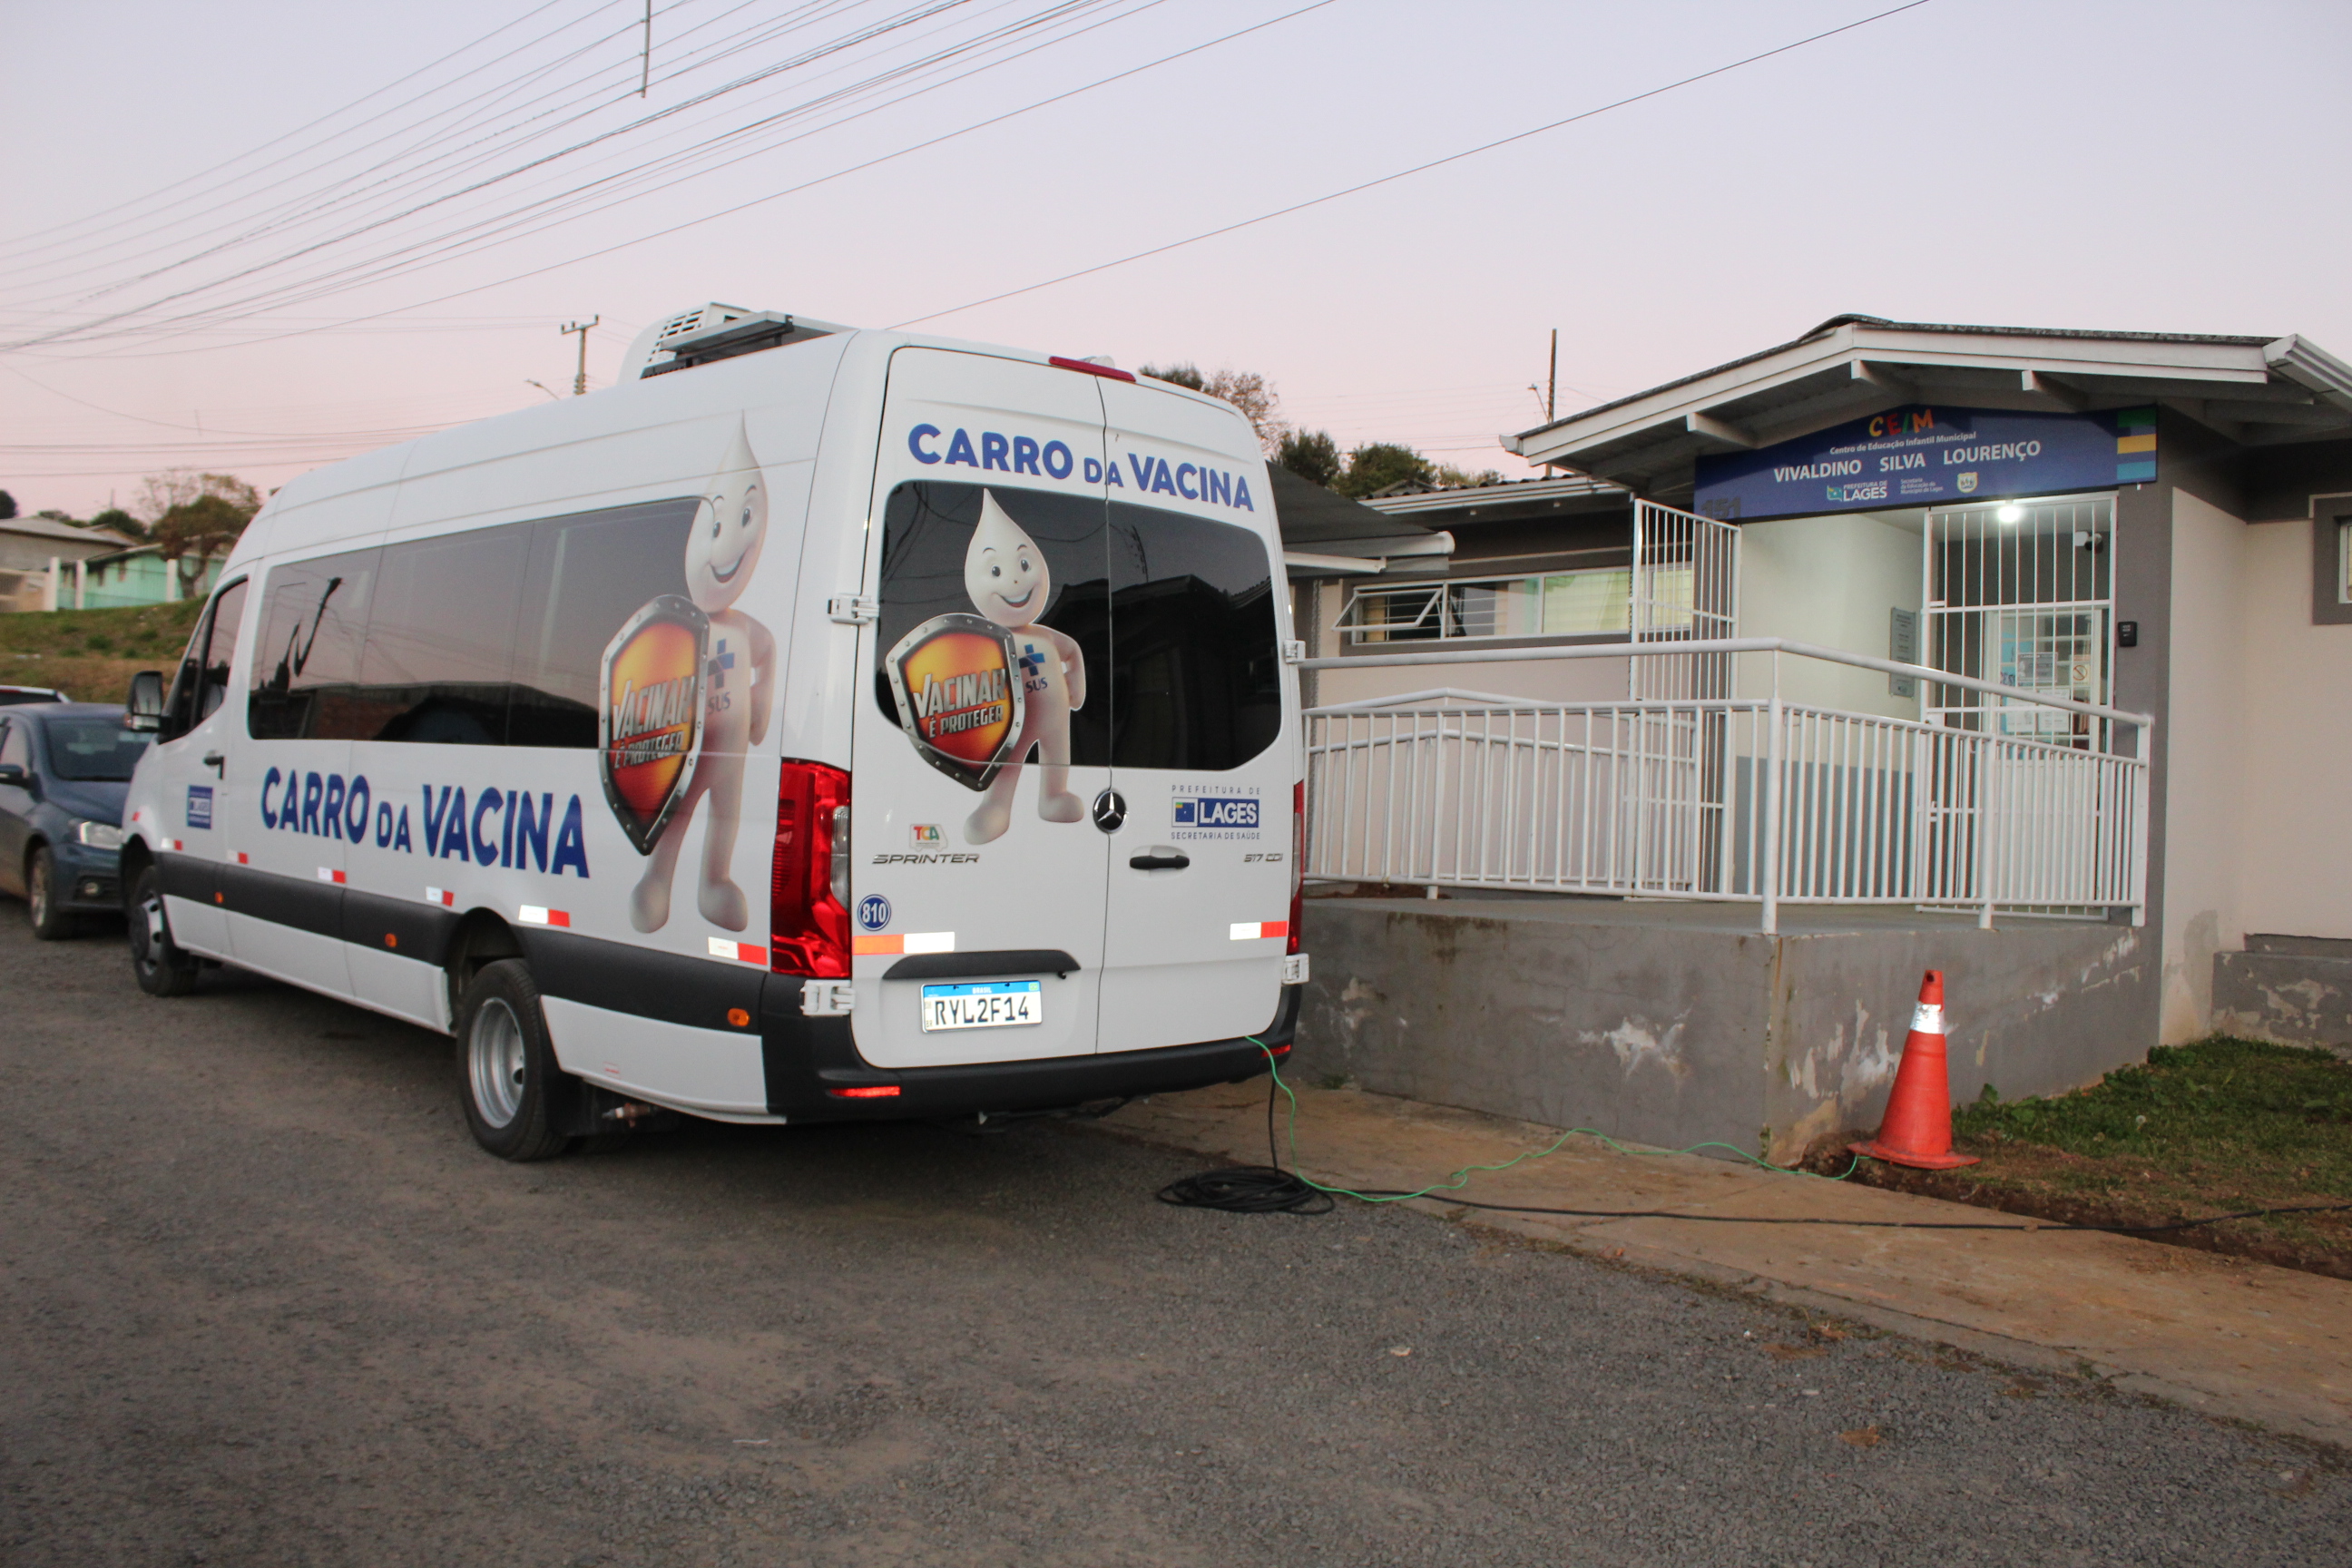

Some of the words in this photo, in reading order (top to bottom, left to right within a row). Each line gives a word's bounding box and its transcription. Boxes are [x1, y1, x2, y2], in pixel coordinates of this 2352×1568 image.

[1869, 408, 1935, 437] CEIM
[1829, 446, 1856, 455] Centro
[1857, 444, 1867, 452] de
[1867, 440, 1905, 450] Educação
[1906, 436, 1935, 446] Infantil
[1936, 431, 1976, 444] Municipal
[907, 423, 1073, 480] CARRO
[1083, 457, 1123, 488] DA
[1127, 453, 1255, 512] VACINA
[1774, 459, 1862, 483] VIVALDINO
[1880, 453, 1926, 472] SILVA
[1943, 440, 2041, 466] LOURENÇO
[1844, 482, 1878, 490] PREFEITURA
[1844, 486, 1888, 502] LAGES
[913, 668, 1006, 719] VACINAR
[1025, 677, 1048, 693] SUS
[612, 675, 695, 741] VACINAR
[708, 691, 730, 715] SUS
[929, 717, 936, 739] É
[940, 704, 1004, 736] PROTEGER
[1171, 785, 1241, 795] PREFEITURA
[1249, 787, 1260, 795] DE
[260, 766, 371, 845] CARRO
[376, 800, 412, 854] DA
[422, 783, 590, 879] VACINA
[1200, 801, 1257, 824] LAGES
[914, 826, 939, 840] TCA
[1171, 831, 1222, 840] SECRETARIA
[1225, 832, 1234, 840] DE
[1237, 830, 1260, 840] SAÚDE
[872, 854, 980, 865] SPRINTER
[1265, 853, 1284, 862] CDI
[862, 902, 887, 924] 810
[972, 986, 992, 995] BRASIL
[935, 995, 1029, 1025] RYL2F14
